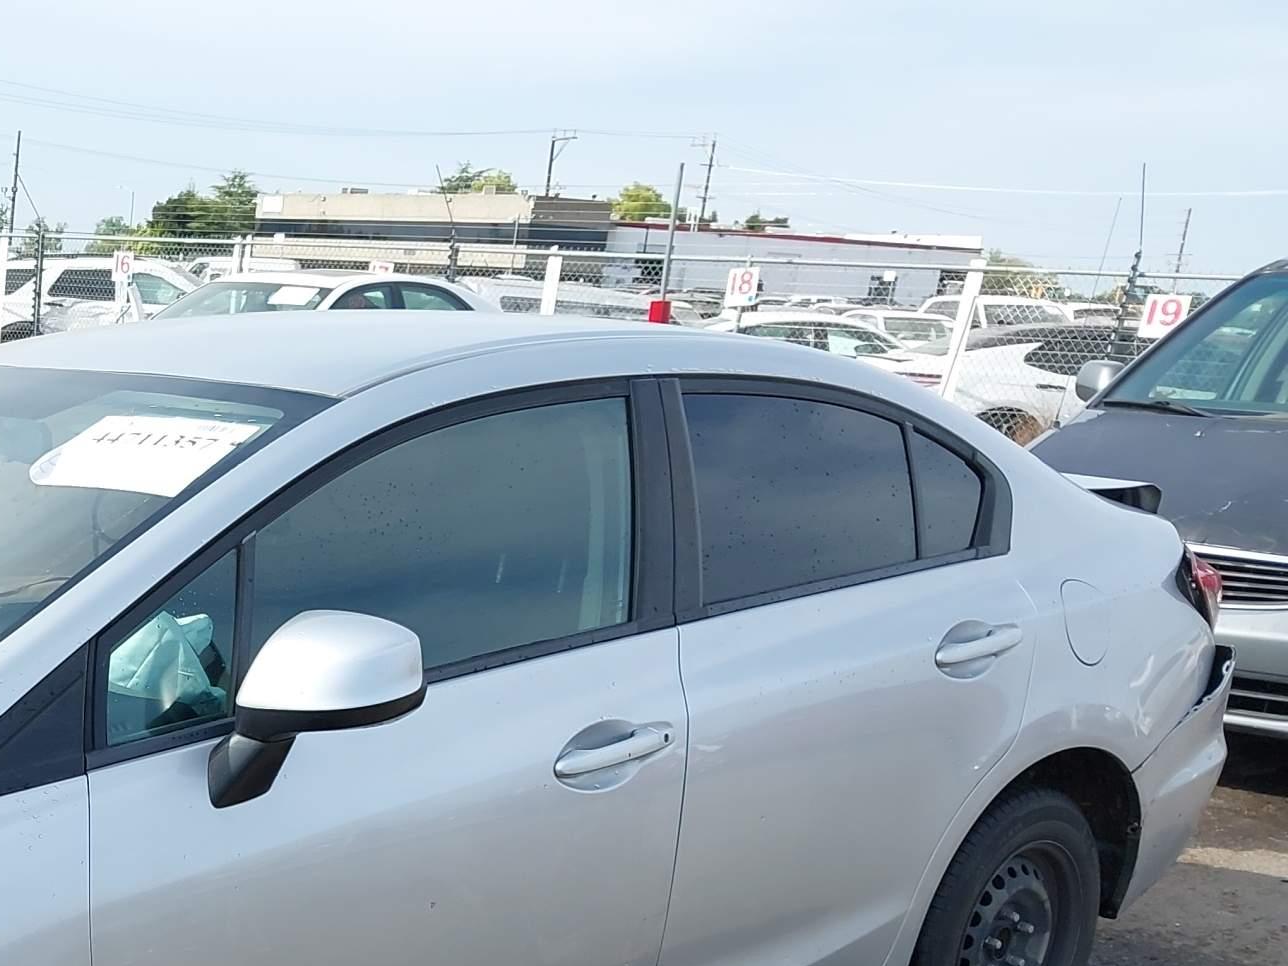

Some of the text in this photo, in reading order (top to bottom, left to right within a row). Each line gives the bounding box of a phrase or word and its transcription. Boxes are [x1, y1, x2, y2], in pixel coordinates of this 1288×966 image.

[114, 253, 131, 274] 16
[730, 271, 754, 296] 18
[1145, 298, 1183, 327] 19
